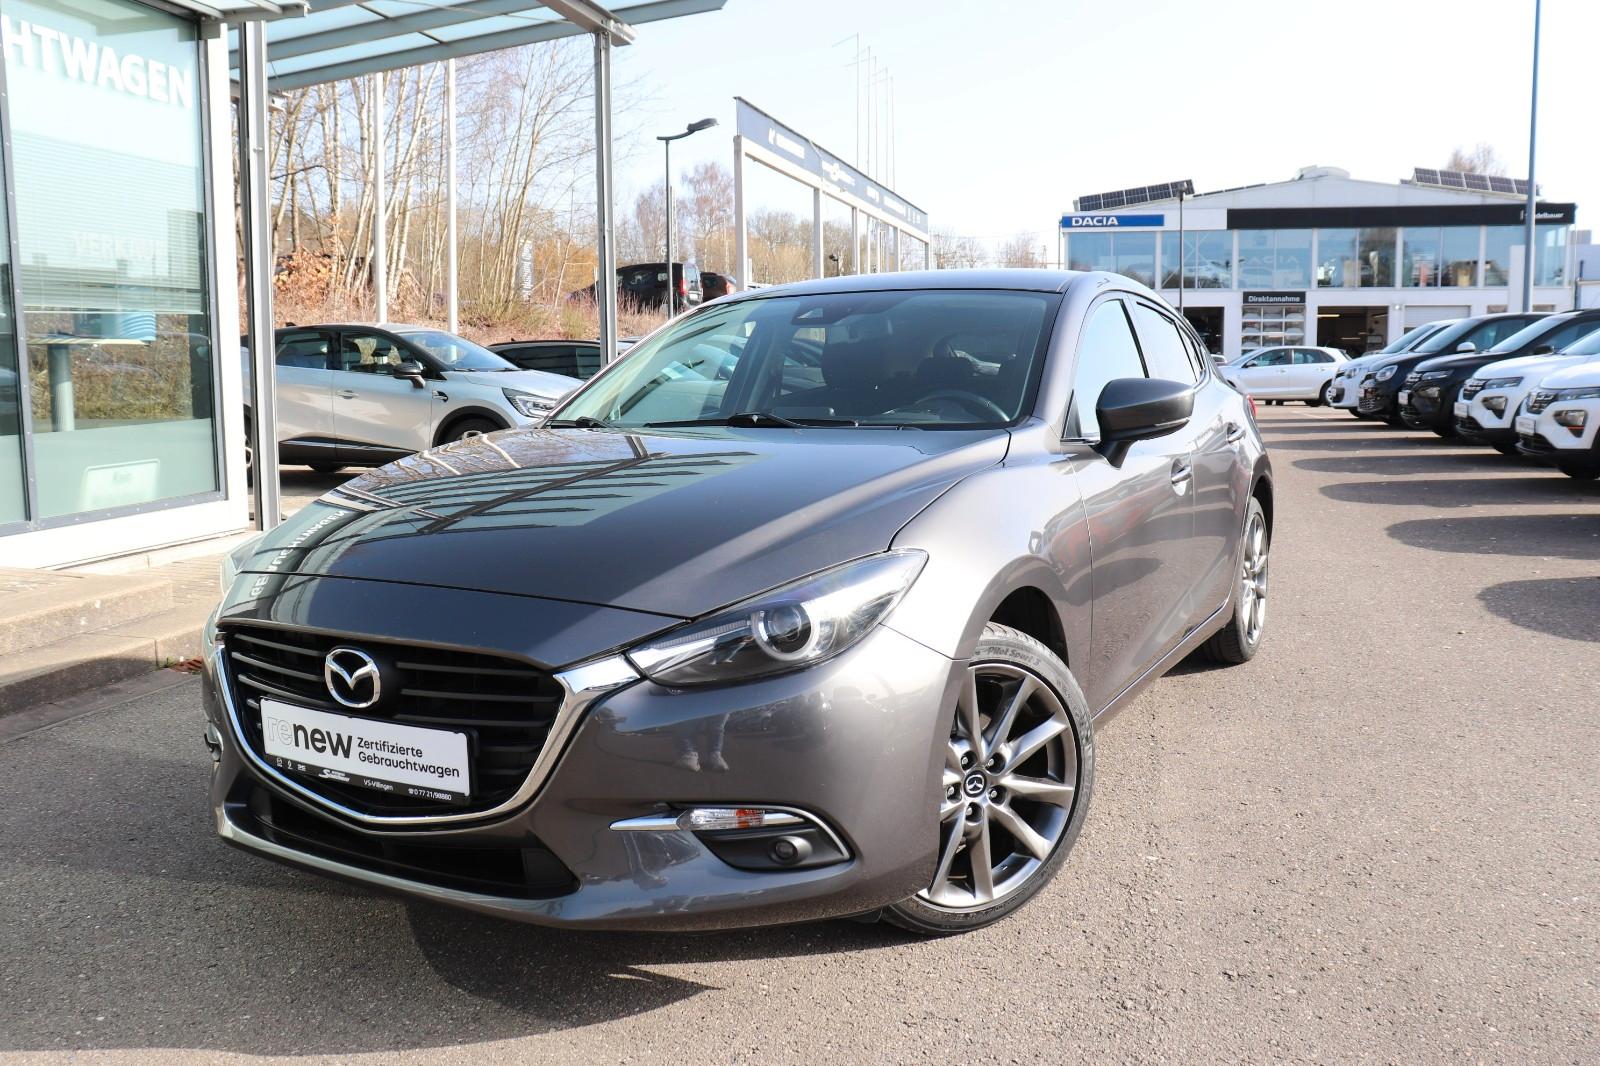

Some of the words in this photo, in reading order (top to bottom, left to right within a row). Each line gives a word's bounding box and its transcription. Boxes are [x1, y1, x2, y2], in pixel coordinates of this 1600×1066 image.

[1072, 216, 1118, 226] DACIA
[1248, 295, 1301, 303] Direktannahme
[988, 646, 1008, 656] Pilot
[266, 716, 353, 759] renew
[357, 736, 423, 759] Zertifizierte
[358, 751, 460, 778] Gebrauchtwagen
